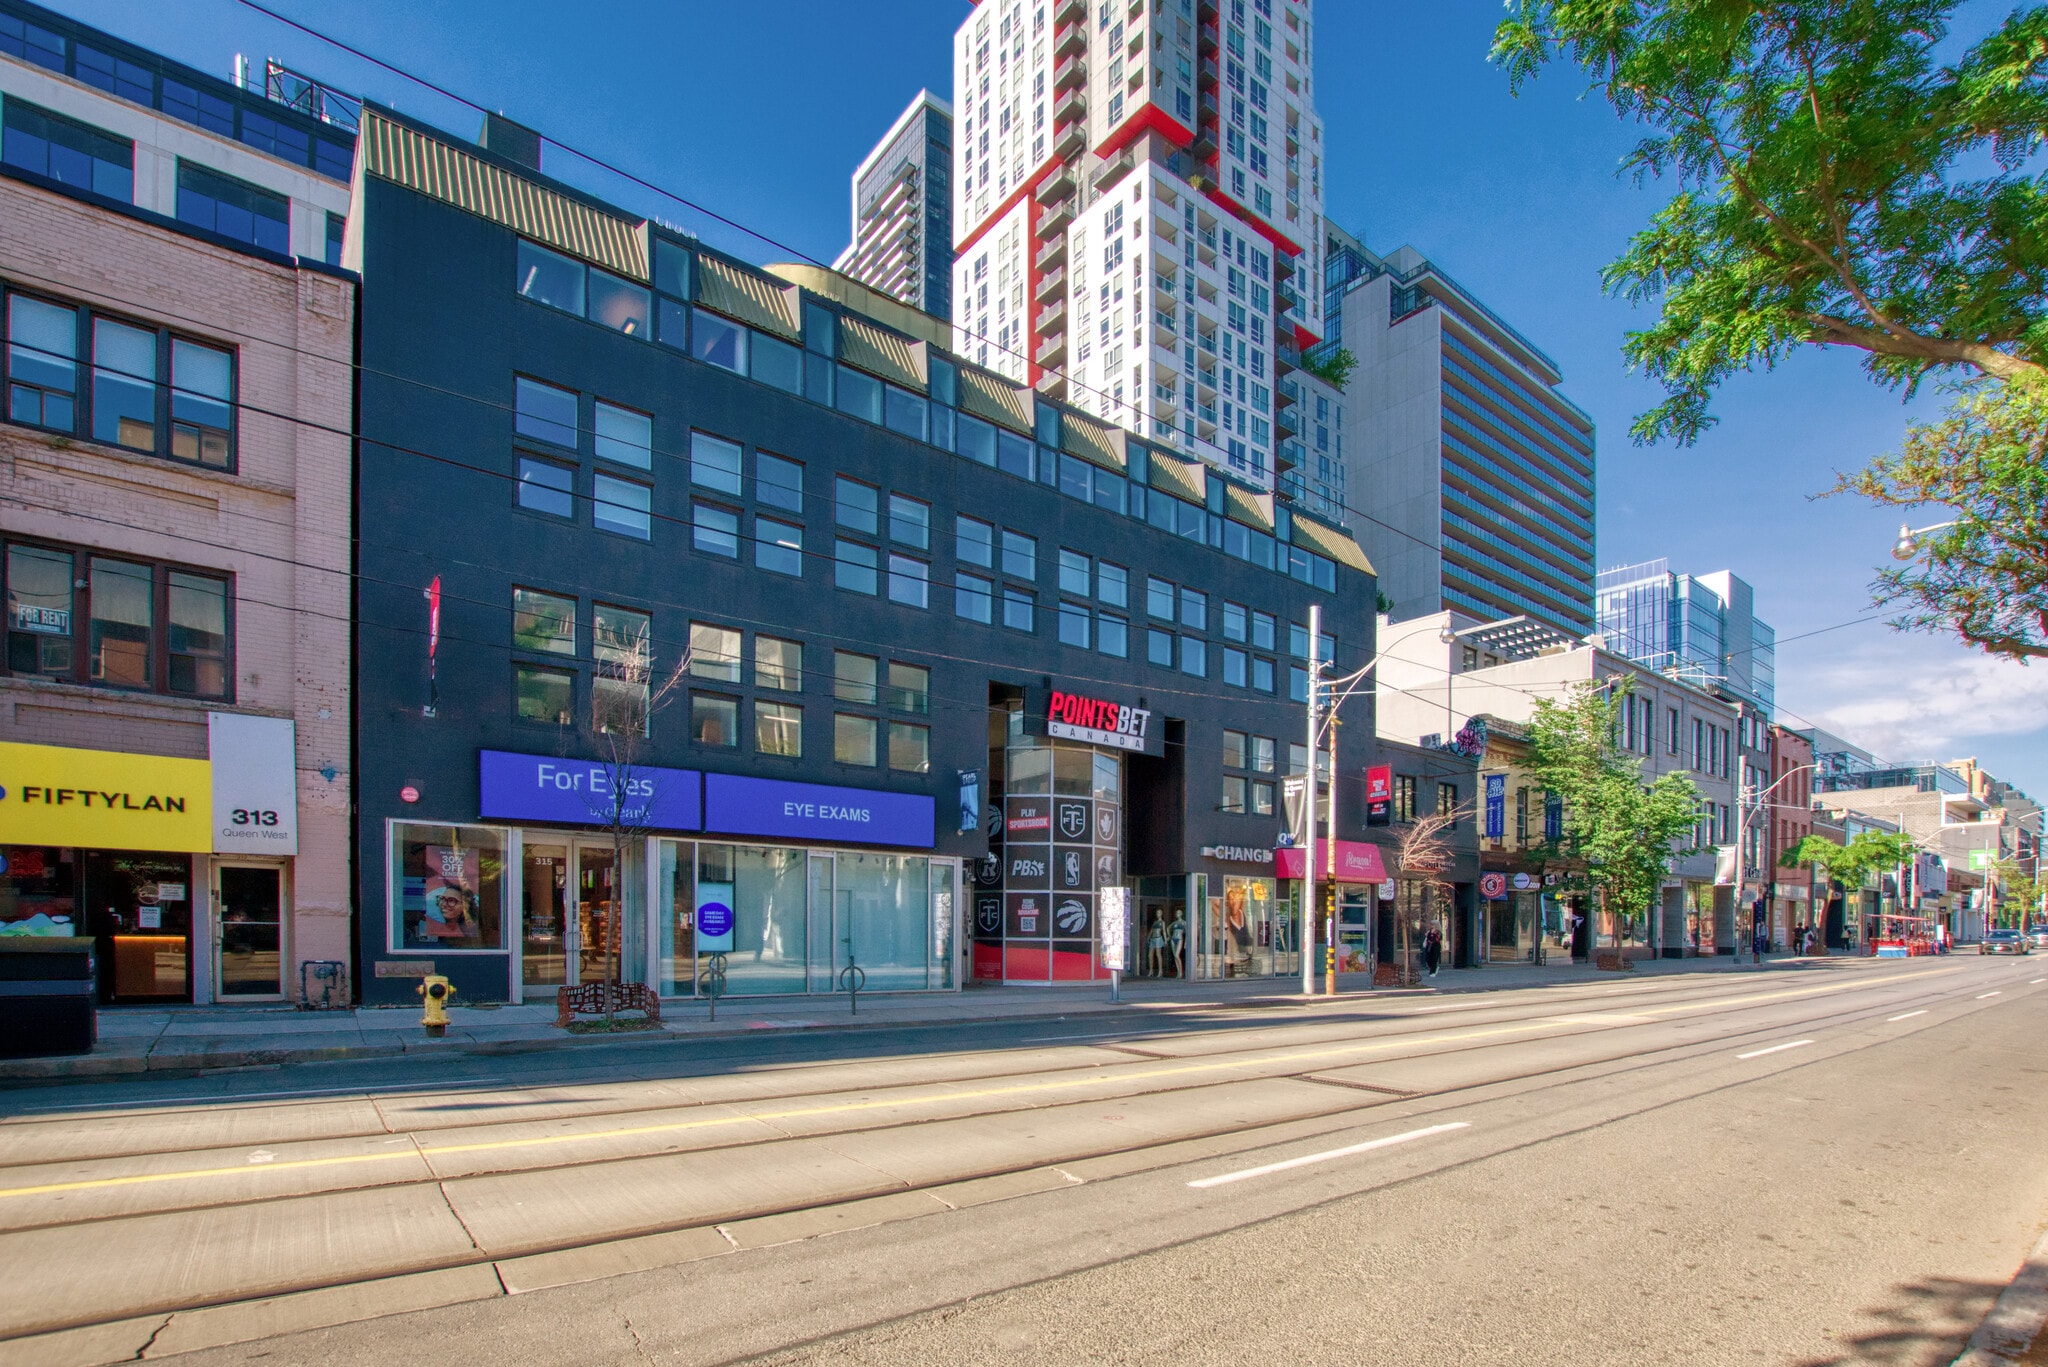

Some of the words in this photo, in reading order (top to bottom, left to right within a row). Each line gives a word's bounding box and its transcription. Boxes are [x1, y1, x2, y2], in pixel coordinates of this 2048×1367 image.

[20, 607, 40, 623] FOR
[42, 610, 67, 627] RENT
[1048, 690, 1151, 737] POINTSBET
[1052, 724, 1141, 749] CANADA
[538, 764, 584, 791] For
[590, 769, 654, 799] Eyes
[23, 786, 186, 813] FIFTYLAN
[232, 809, 279, 826] 313
[784, 802, 815, 818] EYE
[819, 805, 870, 822] EXAMS
[1020, 808, 1037, 818] PLAY
[222, 828, 259, 840] Queen
[261, 830, 288, 840] West
[442, 855, 463, 865] 30%
[535, 857, 553, 866] 315
[1215, 845, 1270, 863] CHANGE
[442, 863, 464, 872] OFF
